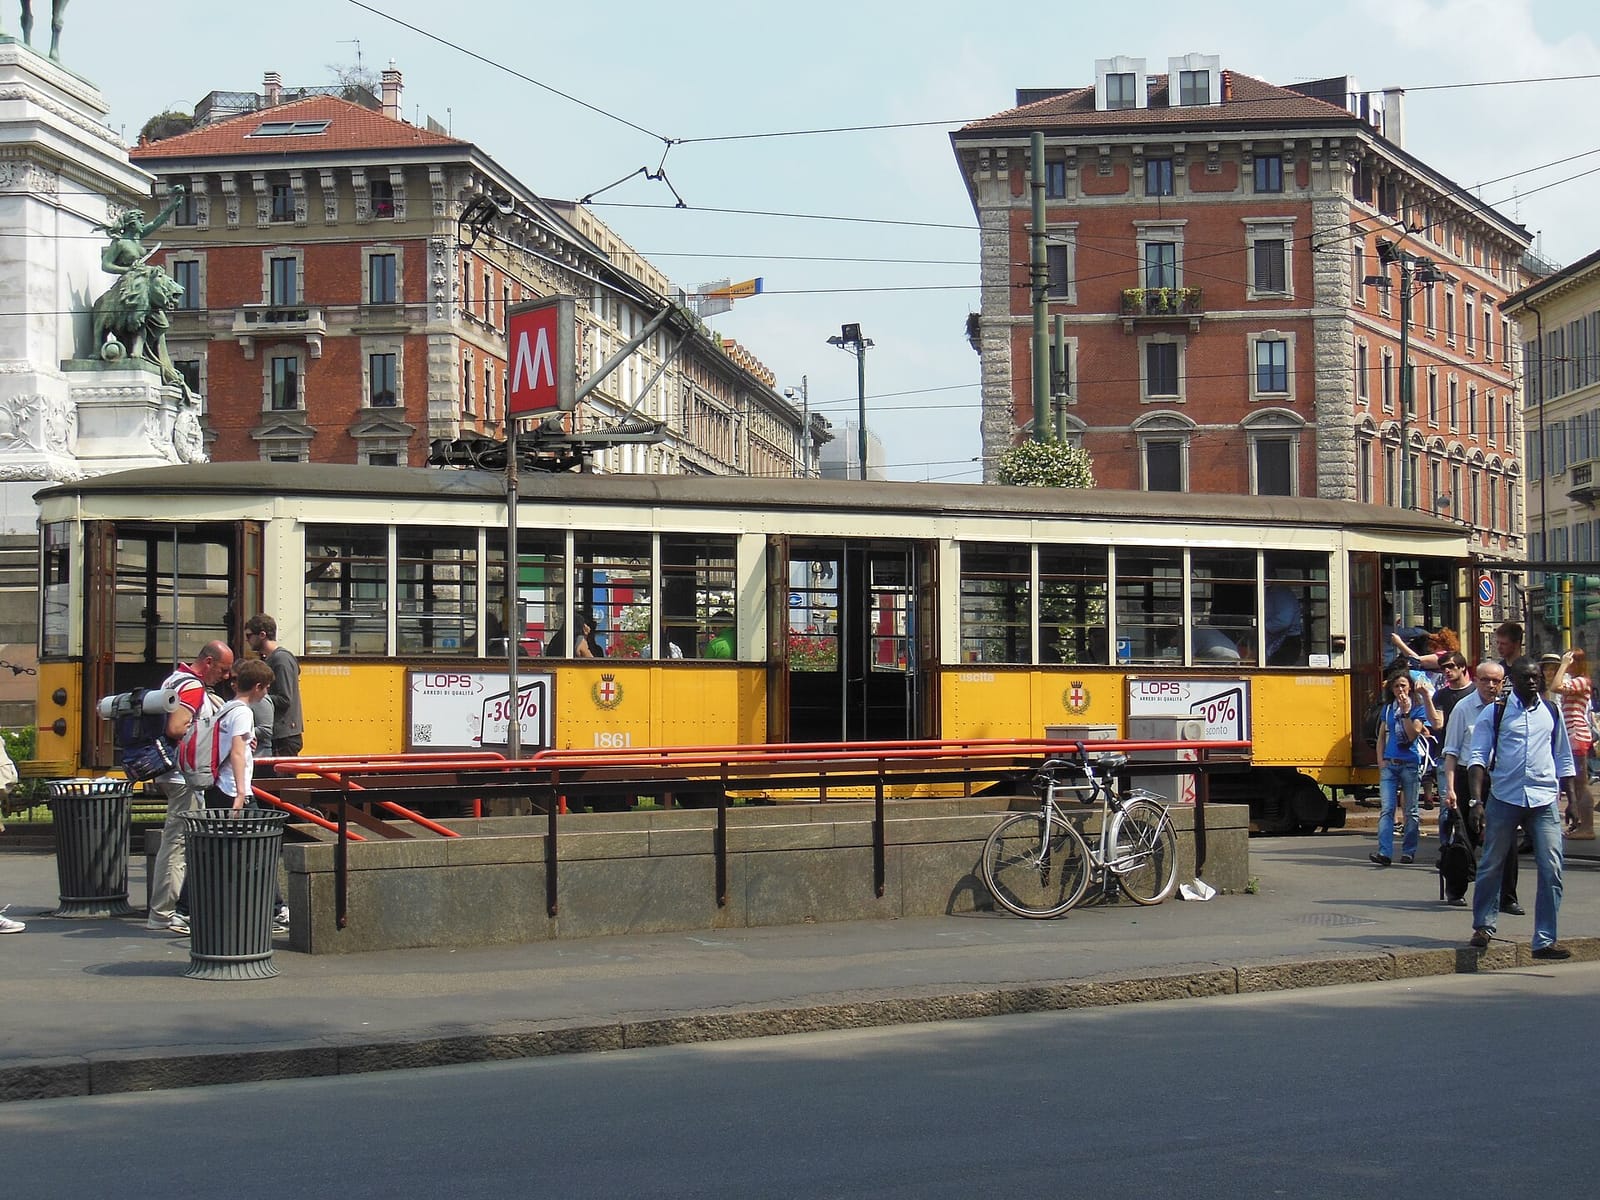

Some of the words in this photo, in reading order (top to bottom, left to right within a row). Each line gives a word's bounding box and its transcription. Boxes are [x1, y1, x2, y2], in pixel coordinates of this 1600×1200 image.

[512, 327, 555, 393] M
[425, 674, 472, 688] LOPS
[1141, 681, 1180, 695] LOPS
[593, 732, 631, 749] 1861
